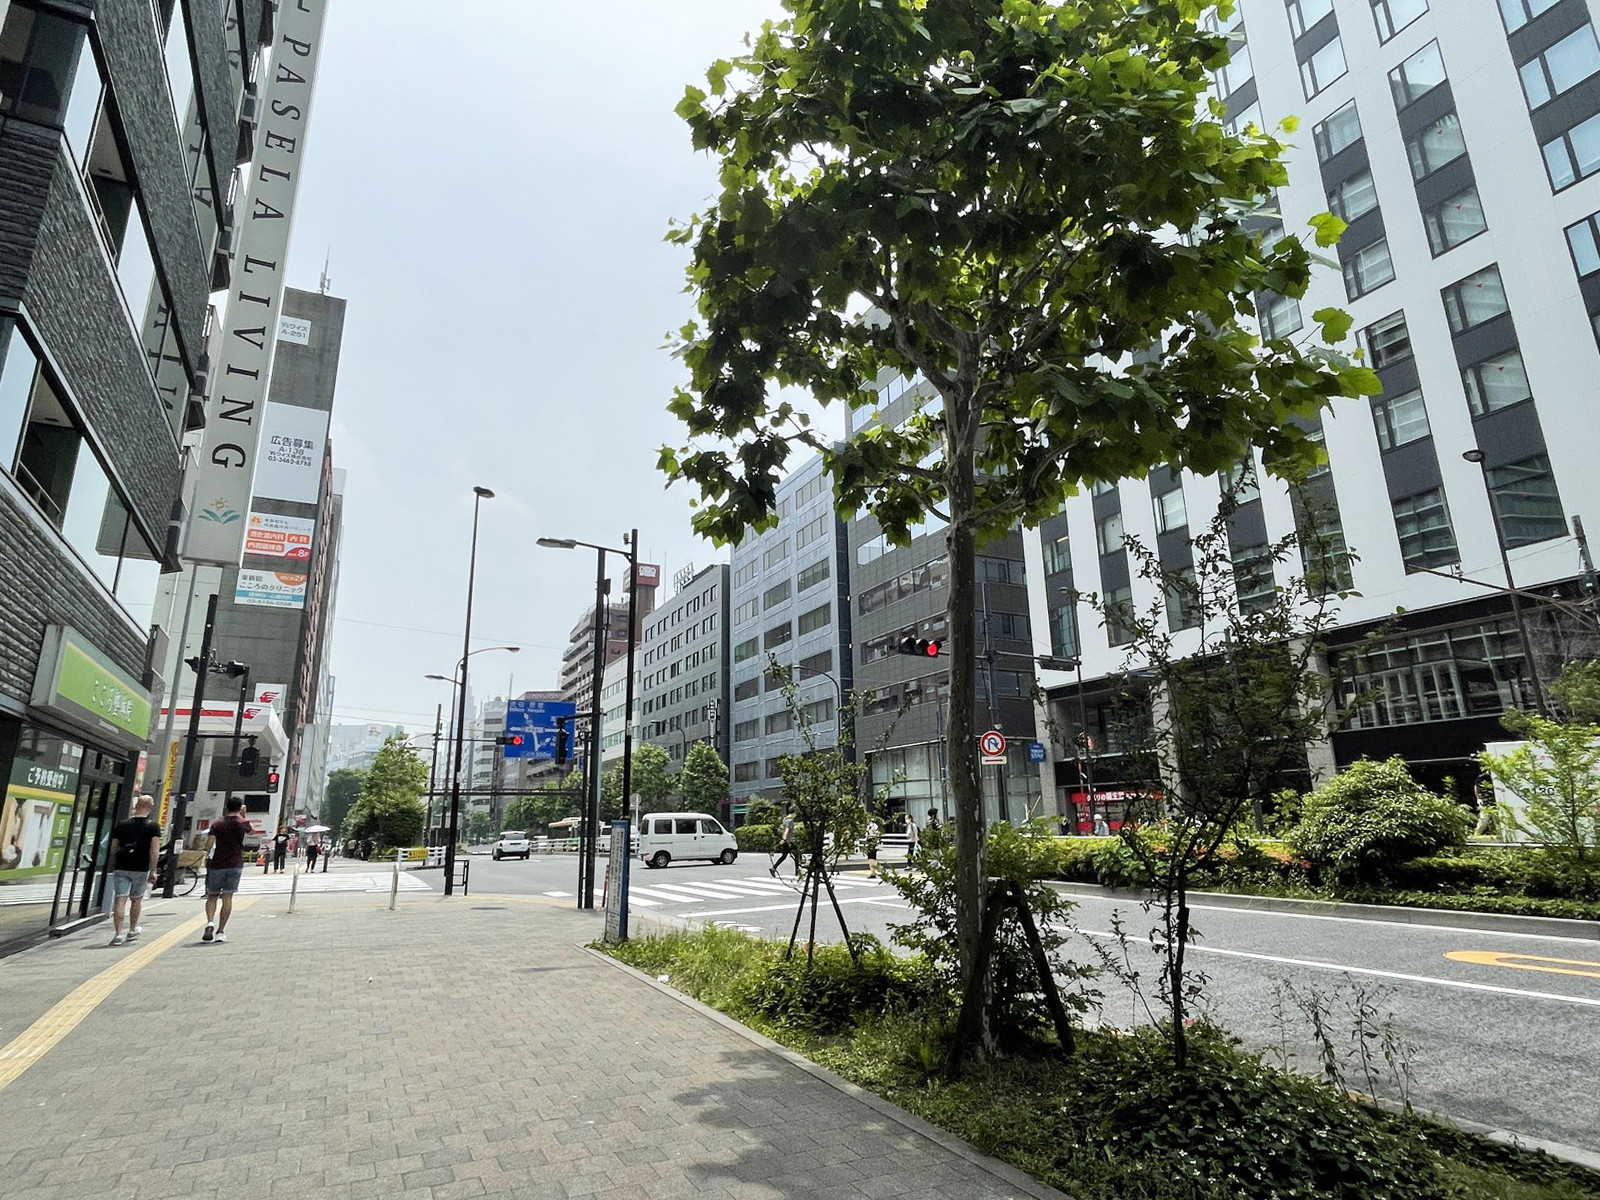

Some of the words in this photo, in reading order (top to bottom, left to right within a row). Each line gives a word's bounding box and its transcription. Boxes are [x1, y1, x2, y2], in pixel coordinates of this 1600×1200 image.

[252, 33, 312, 220] PASELA
[281, 329, 306, 338] A-251
[211, 254, 277, 469] LIVING
[271, 435, 314, 450] 広告募集
[239, 582, 304, 593] こころのクリニック
